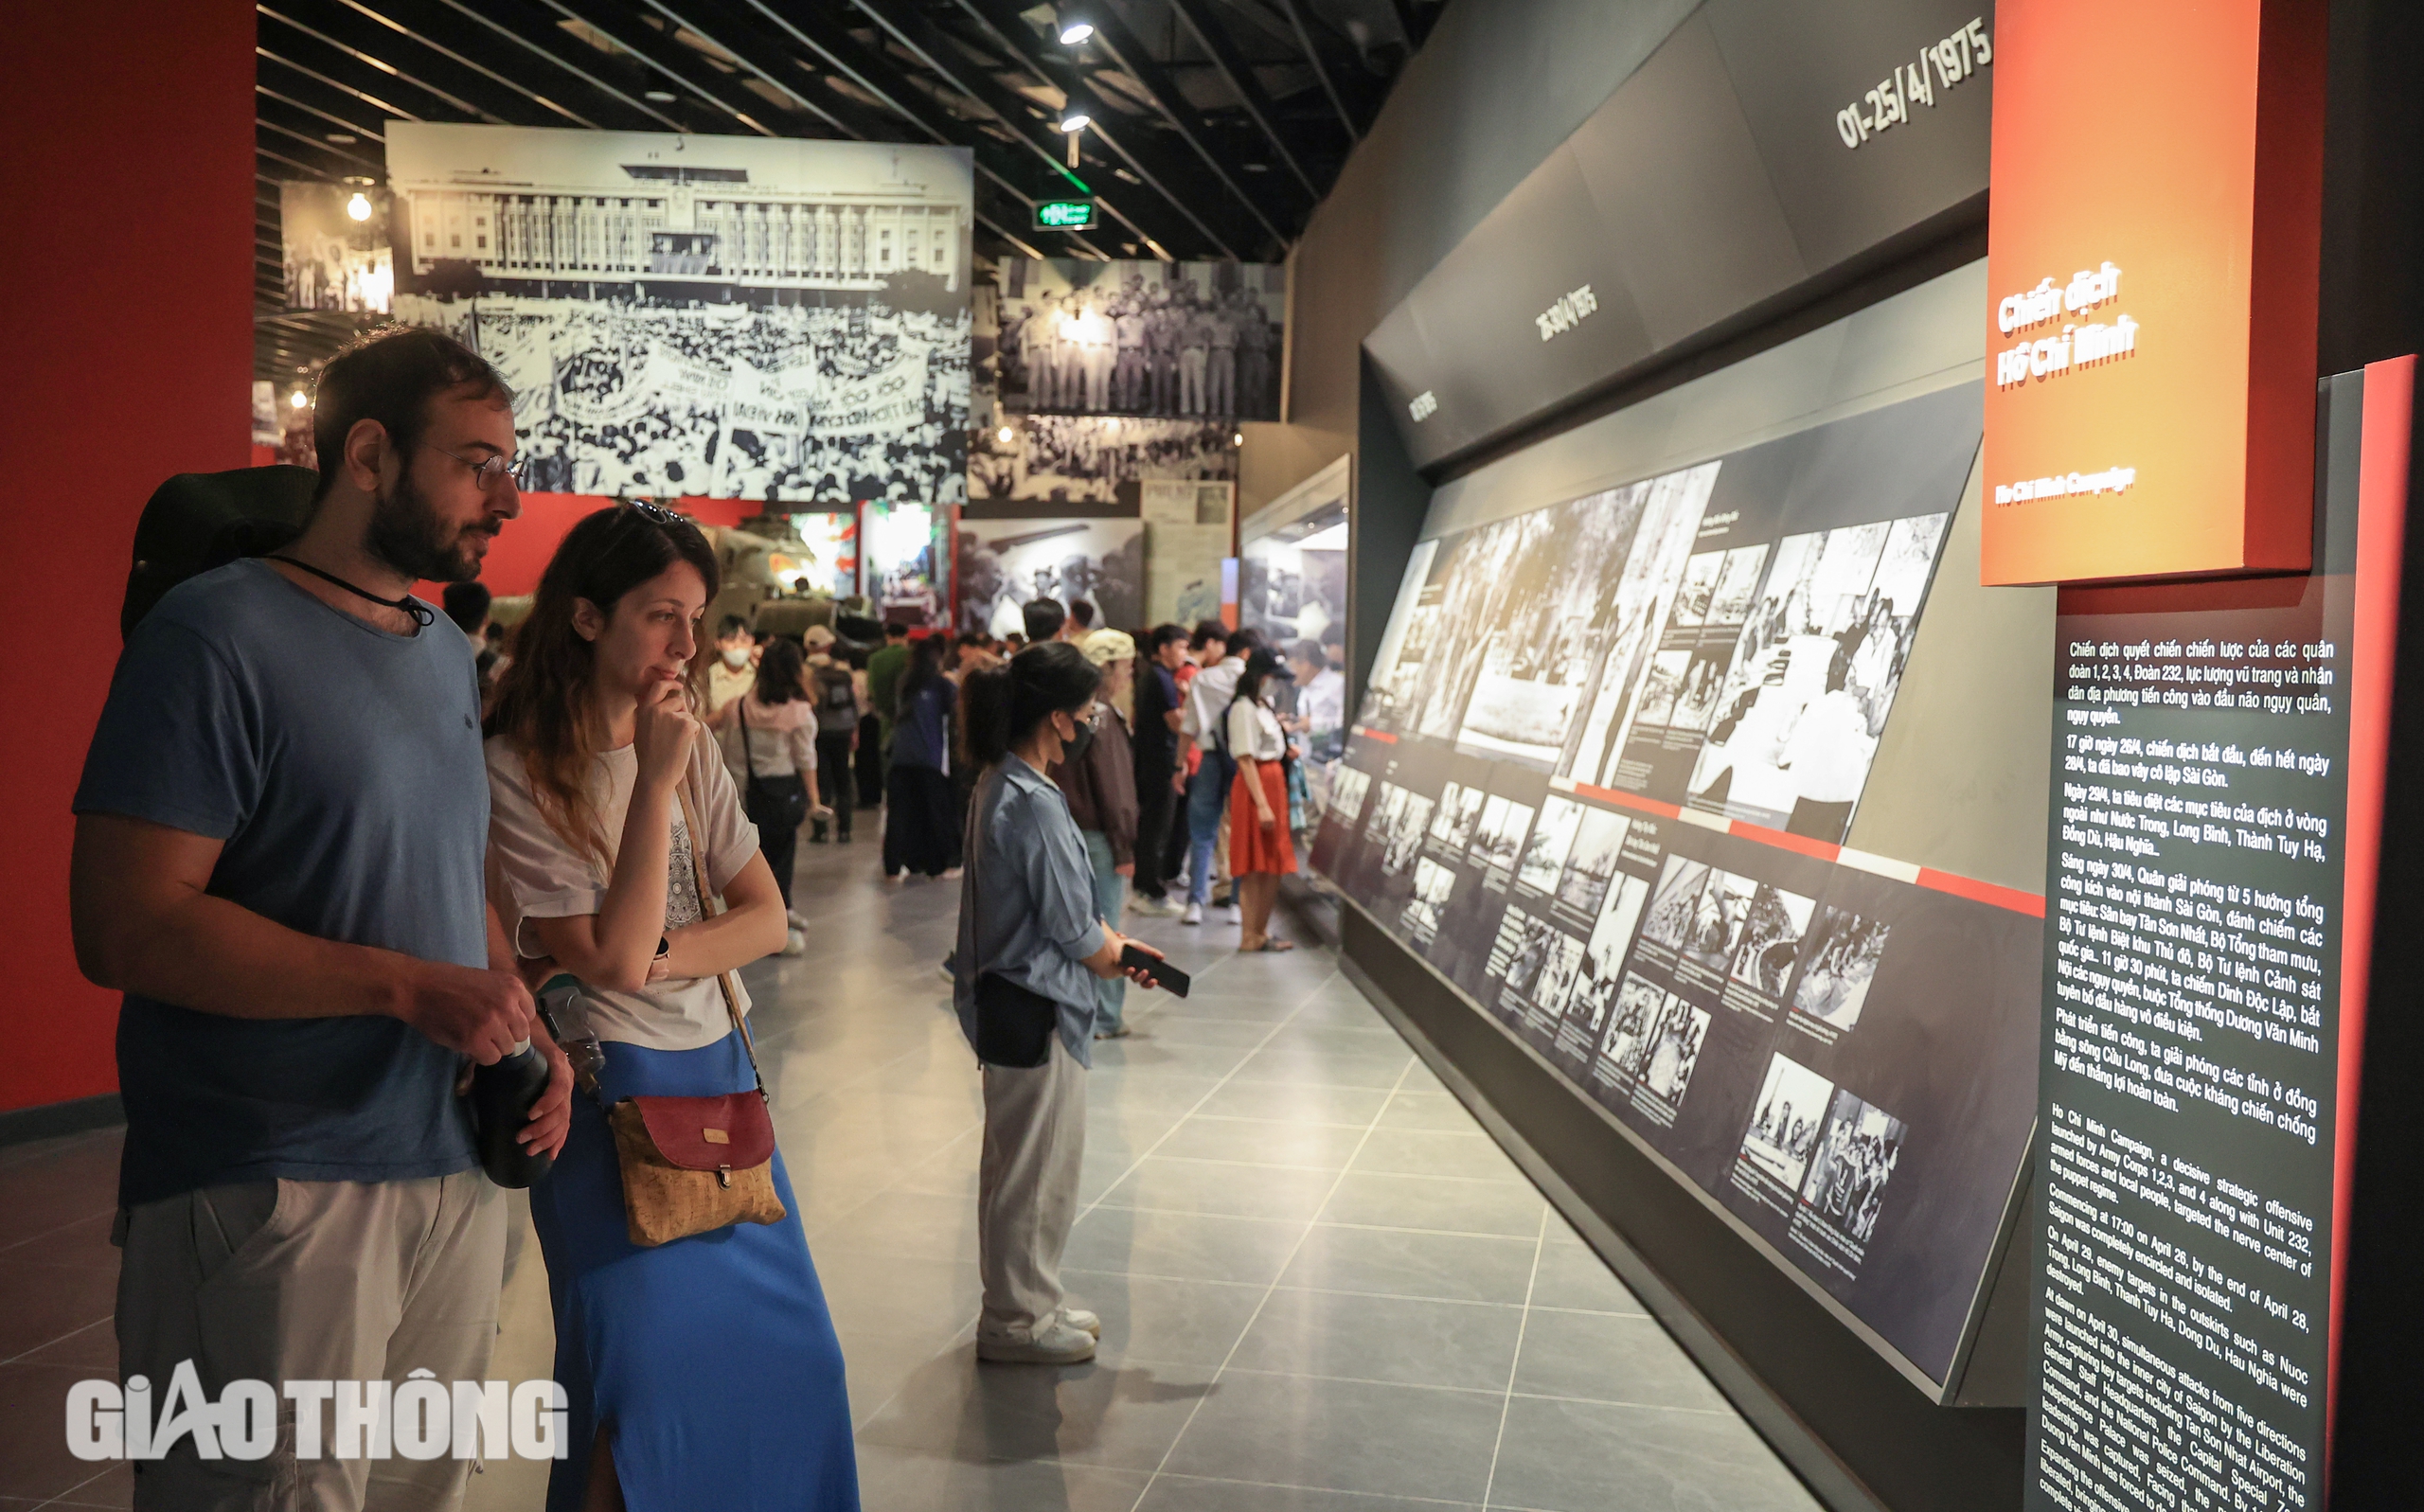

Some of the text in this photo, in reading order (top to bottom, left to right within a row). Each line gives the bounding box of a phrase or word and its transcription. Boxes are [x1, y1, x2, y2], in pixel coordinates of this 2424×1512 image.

[1836, 16, 1992, 149] 01-25/4/1975
[2068, 685, 2085, 701] dân
[2087, 685, 2102, 704] địa
[2103, 685, 2139, 707] phương
[2141, 685, 2161, 704] tiến
[2162, 687, 2189, 710] công
[2191, 688, 2212, 706] vào
[2213, 687, 2235, 707] đầu
[2237, 690, 2260, 708] não
[2263, 695, 2293, 715] ngụy
[2069, 638, 2334, 662] Chiến dịch quyết chiến chiến lược của các quân
[2069, 663, 2092, 679] đoàn
[2133, 664, 2161, 681] Đoàn
[2185, 665, 2202, 685] lực
[2203, 665, 2234, 686] lượng
[2235, 666, 2250, 683] vũ
[2251, 667, 2282, 688] trang
[2284, 666, 2299, 685] và
[2301, 666, 2333, 685] nhân
[2066, 734, 2078, 749] 17
[2078, 734, 2094, 755] giờ
[2094, 736, 2119, 757] ngày
[2145, 738, 2174, 758] chiến
[2175, 741, 2200, 763] dịch
[2201, 741, 2220, 763] bắt
[2249, 746, 2272, 767] đến
[2274, 748, 2296, 770] hết
[2298, 753, 2330, 777] ngày
[2060, 851, 2085, 875] Sáng
[2086, 858, 2110, 880] ngày
[2137, 866, 2166, 888] Quân
[2167, 872, 2187, 894] giải
[2189, 878, 2224, 904] phóng
[2227, 884, 2240, 903] từ
[2242, 887, 2251, 906] 5
[2254, 889, 2292, 918] hướng
[2295, 895, 2324, 925] tổng
[2062, 805, 2089, 824] ngoài
[2090, 808, 2109, 826] như
[2110, 809, 2140, 829] Nước
[2173, 819, 2201, 845] Long
[2236, 828, 2273, 851] Thành
[2276, 834, 2300, 860] Tuy
[2056, 1006, 2076, 1028] Phát
[2077, 1014, 2099, 1036] triển
[2100, 1023, 2119, 1043] tiến
[2149, 1041, 2162, 1058] ta
[2163, 1045, 2183, 1066] giải
[2184, 1054, 2220, 1083] phóng
[2222, 1067, 2244, 1088] các
[2247, 1072, 2270, 1097] tỉnh
[2272, 1080, 2282, 1101] ở
[2285, 1087, 2317, 1118] đồng
[2050, 1142, 2312, 1278] armed forces and local people, targeted the nerve center of
[2051, 1120, 2312, 1257] launched by Army Corps 1,2,3, and 4 along with Unit 232,
[2052, 1102, 2313, 1232] Ho Chi Minh Campaign, a decisive strategic offensive
[2047, 1224, 2308, 1385] On April 29, enemy targets in the outskirts such as Nuoc
[2049, 1182, 2309, 1334] Commencing at 17:00 on April 26, by the end of April 28,
[2045, 1287, 2307, 1462] At dawn on April 30, simultaneous attacks from five directions
